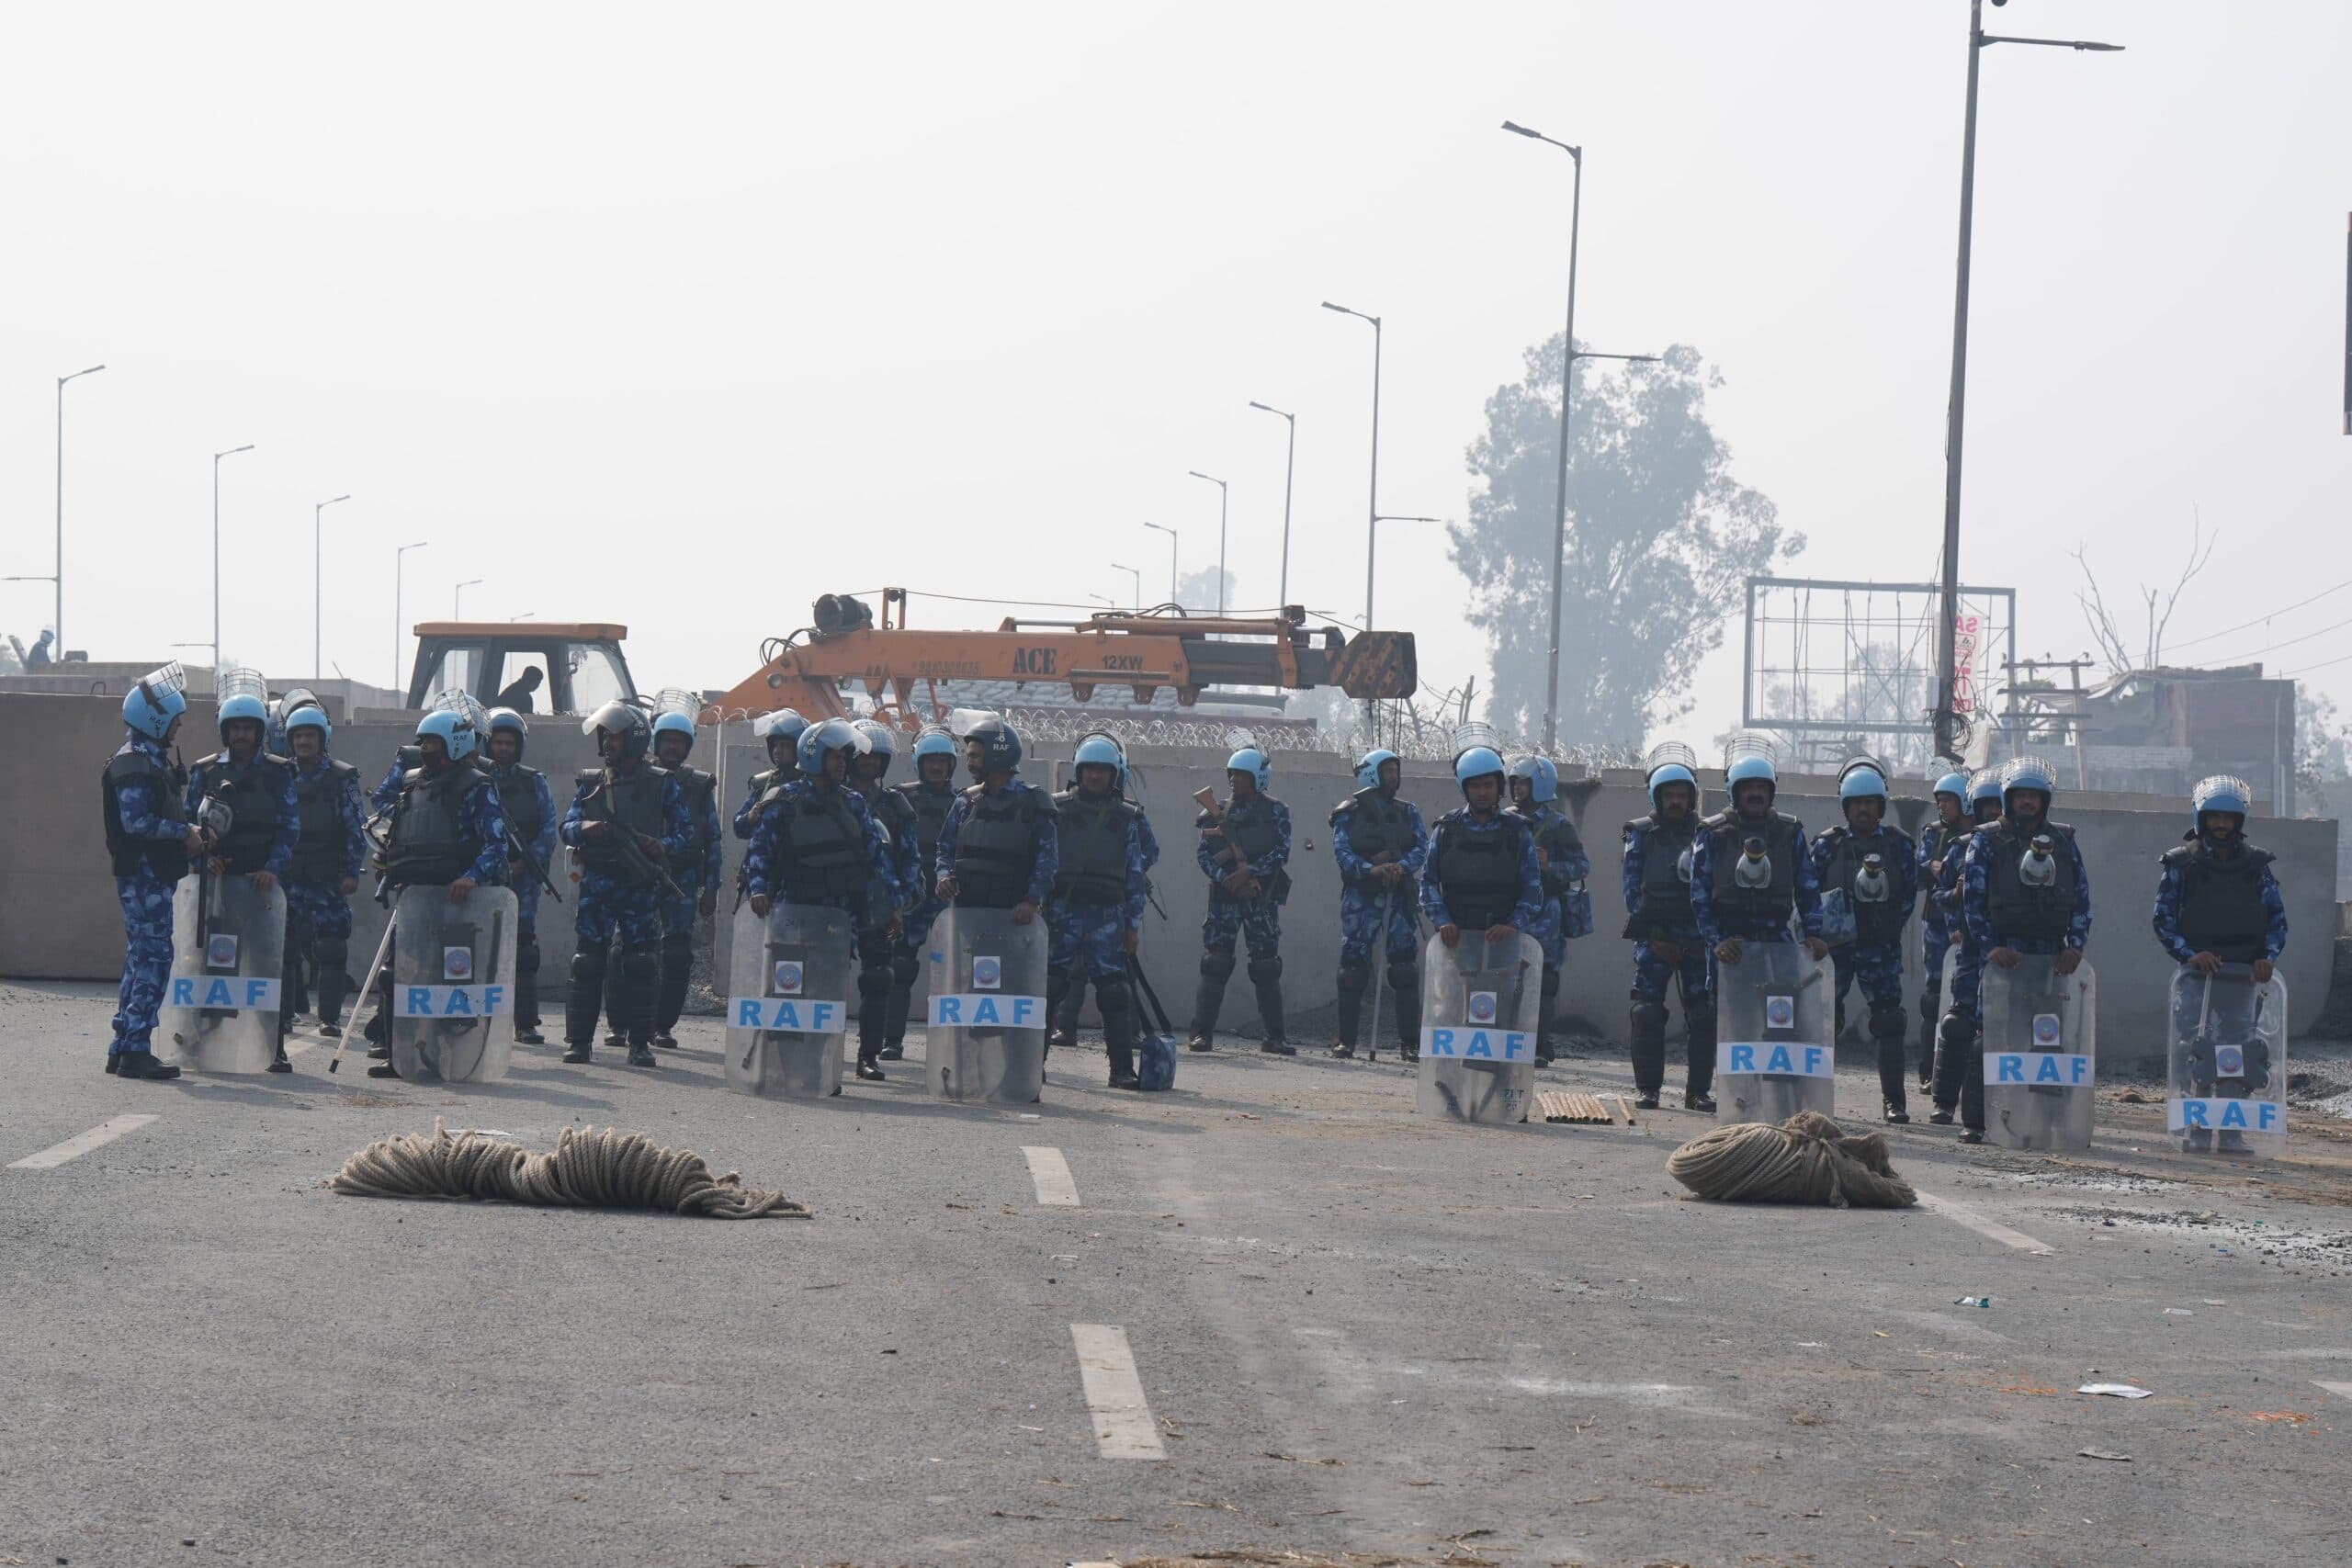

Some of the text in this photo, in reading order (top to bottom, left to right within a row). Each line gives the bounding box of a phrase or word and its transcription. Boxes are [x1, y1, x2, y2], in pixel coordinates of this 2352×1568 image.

[1012, 647, 1057, 674] ACE
[1102, 654, 1143, 670] 12XW
[803, 745, 817, 756] RAF
